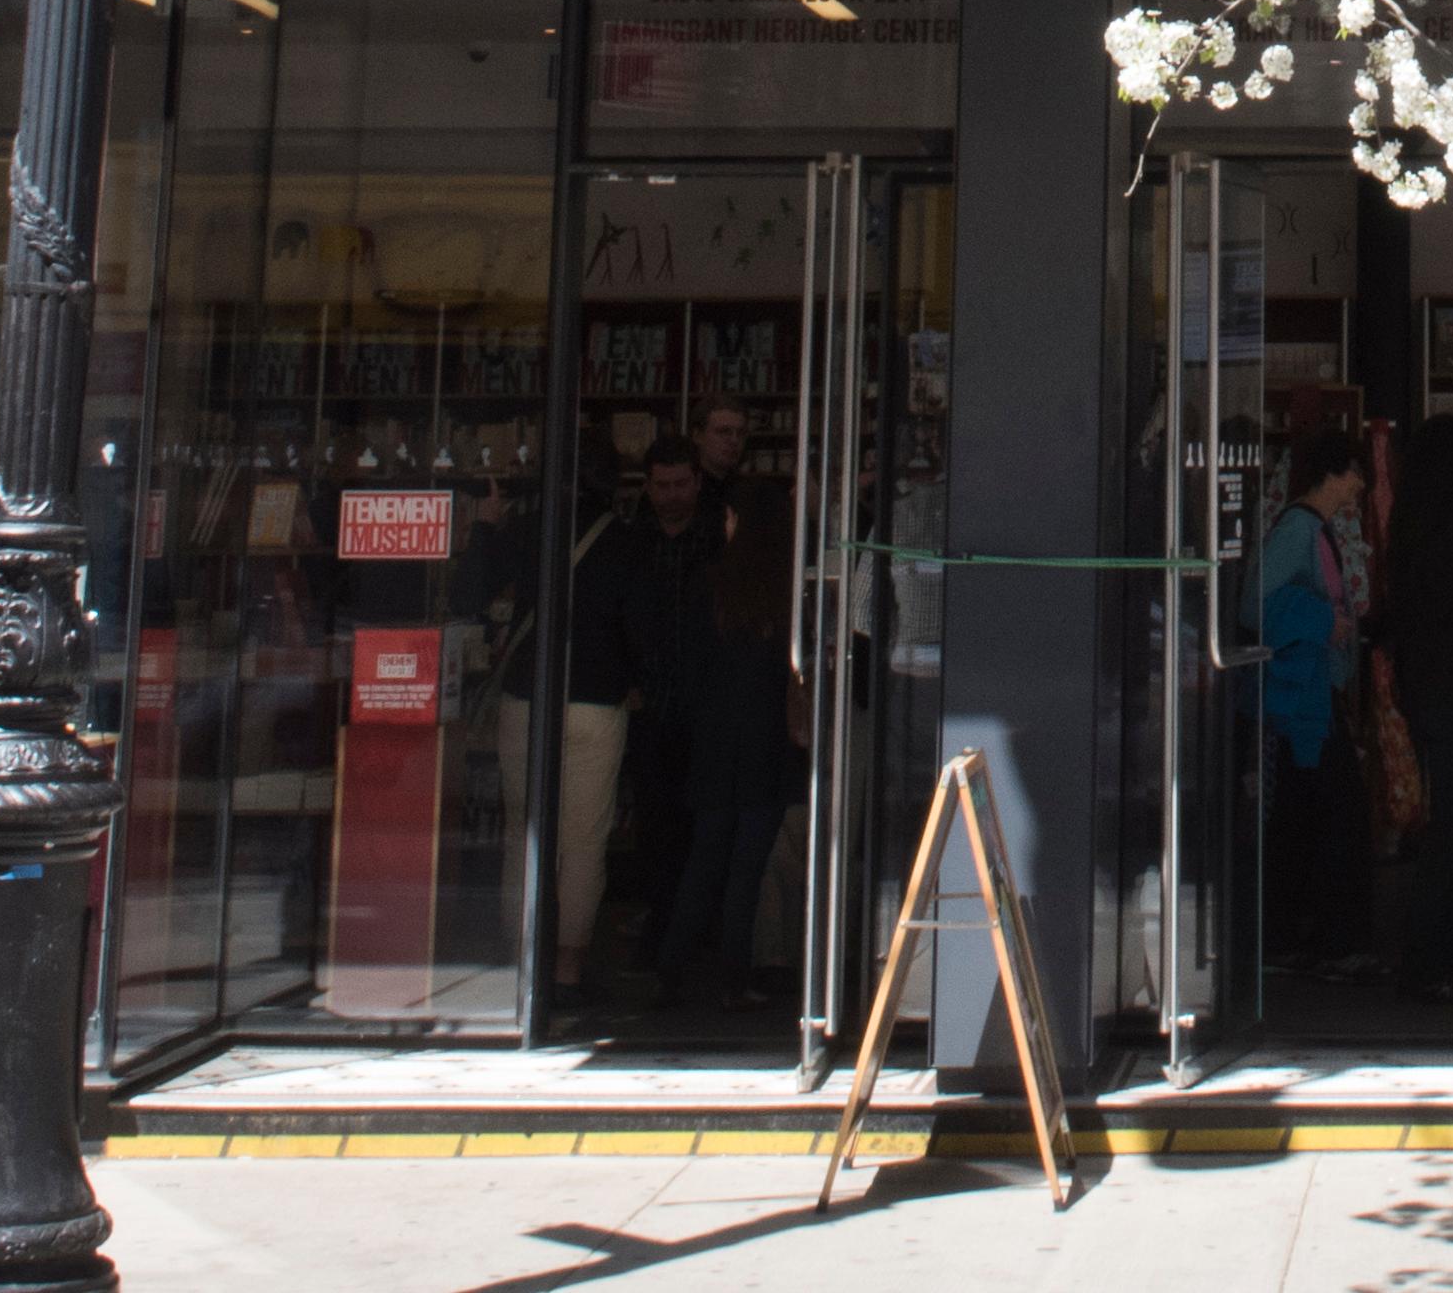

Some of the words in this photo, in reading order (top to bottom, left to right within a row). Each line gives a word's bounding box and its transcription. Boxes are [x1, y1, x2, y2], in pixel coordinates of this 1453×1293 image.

[610, 19, 747, 44] IMMIGRANT
[754, 18, 866, 44] HERITAGE
[873, 18, 961, 43] CENTER
[343, 496, 452, 524] TENEMENT
[344, 525, 447, 554] MUSEUM
